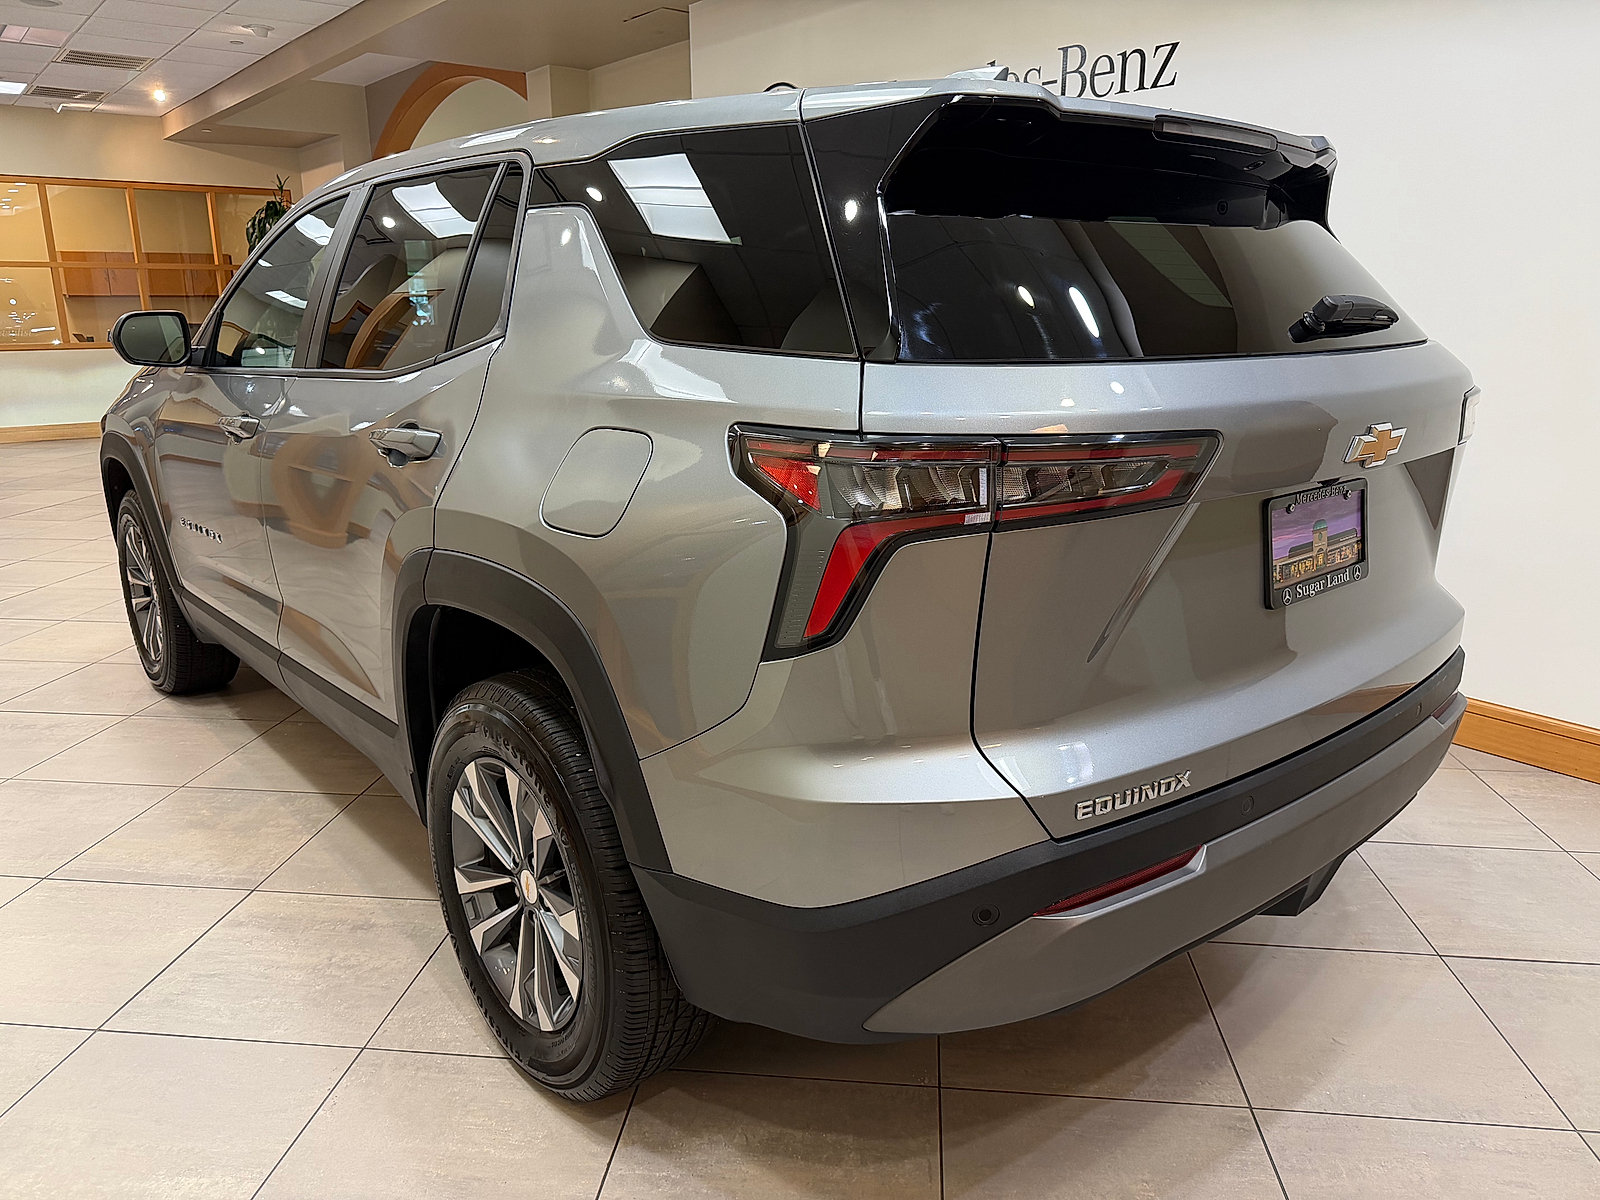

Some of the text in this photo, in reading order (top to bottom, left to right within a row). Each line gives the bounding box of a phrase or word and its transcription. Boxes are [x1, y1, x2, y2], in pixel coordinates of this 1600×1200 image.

[1296, 568, 1350, 598] Sugar Land
[1075, 769, 1191, 821] EQUINOX
